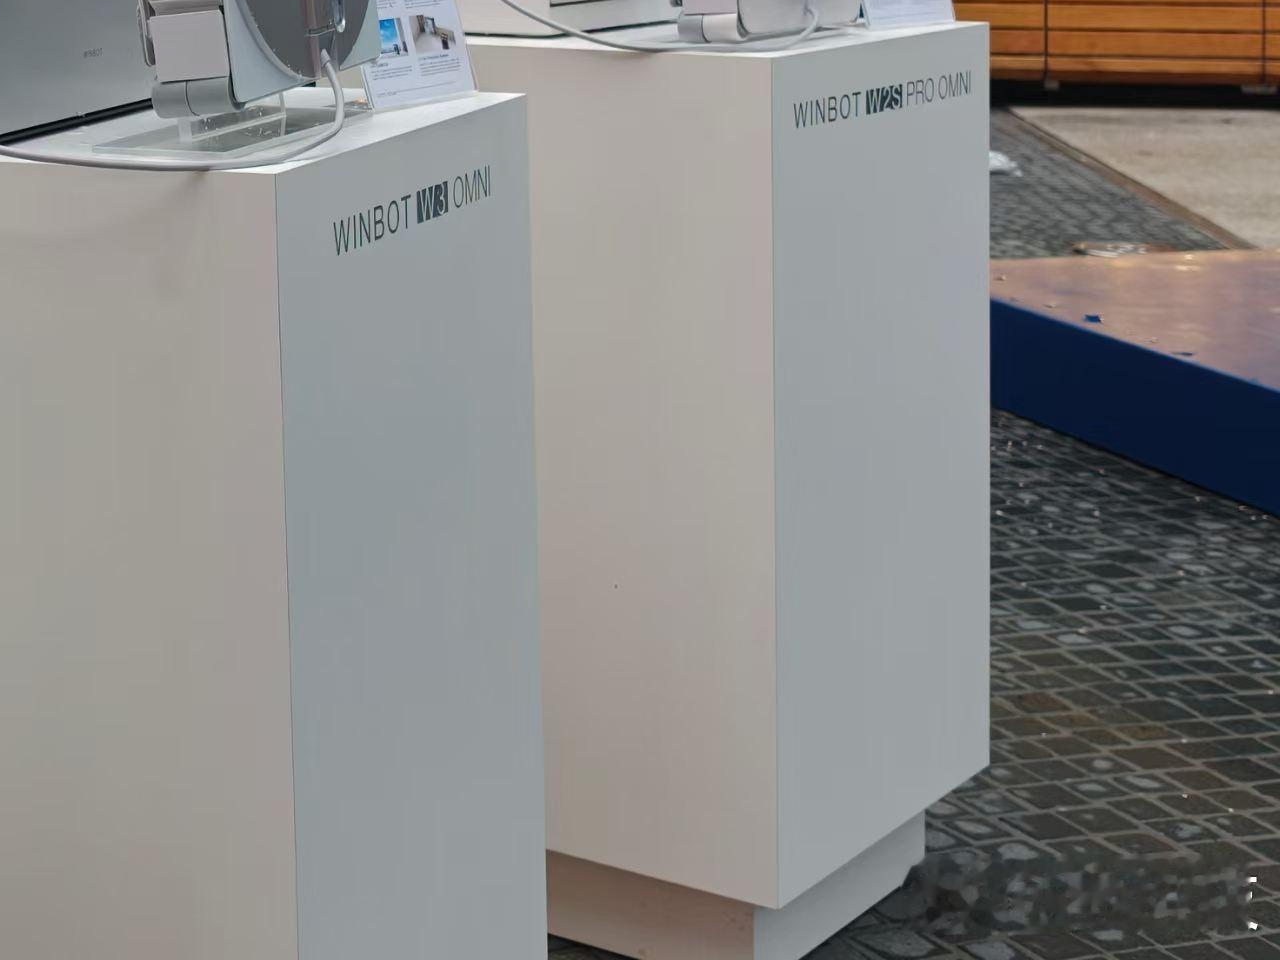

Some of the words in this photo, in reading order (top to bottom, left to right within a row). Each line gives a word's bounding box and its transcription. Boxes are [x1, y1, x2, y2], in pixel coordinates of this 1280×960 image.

[793, 92, 861, 128] WINBOT
[866, 84, 903, 115] W2S
[906, 78, 935, 106] PRO
[938, 71, 971, 99] OMNI
[333, 194, 411, 256] WINBOT
[417, 181, 448, 224] W3
[453, 165, 490, 209] OMNI
